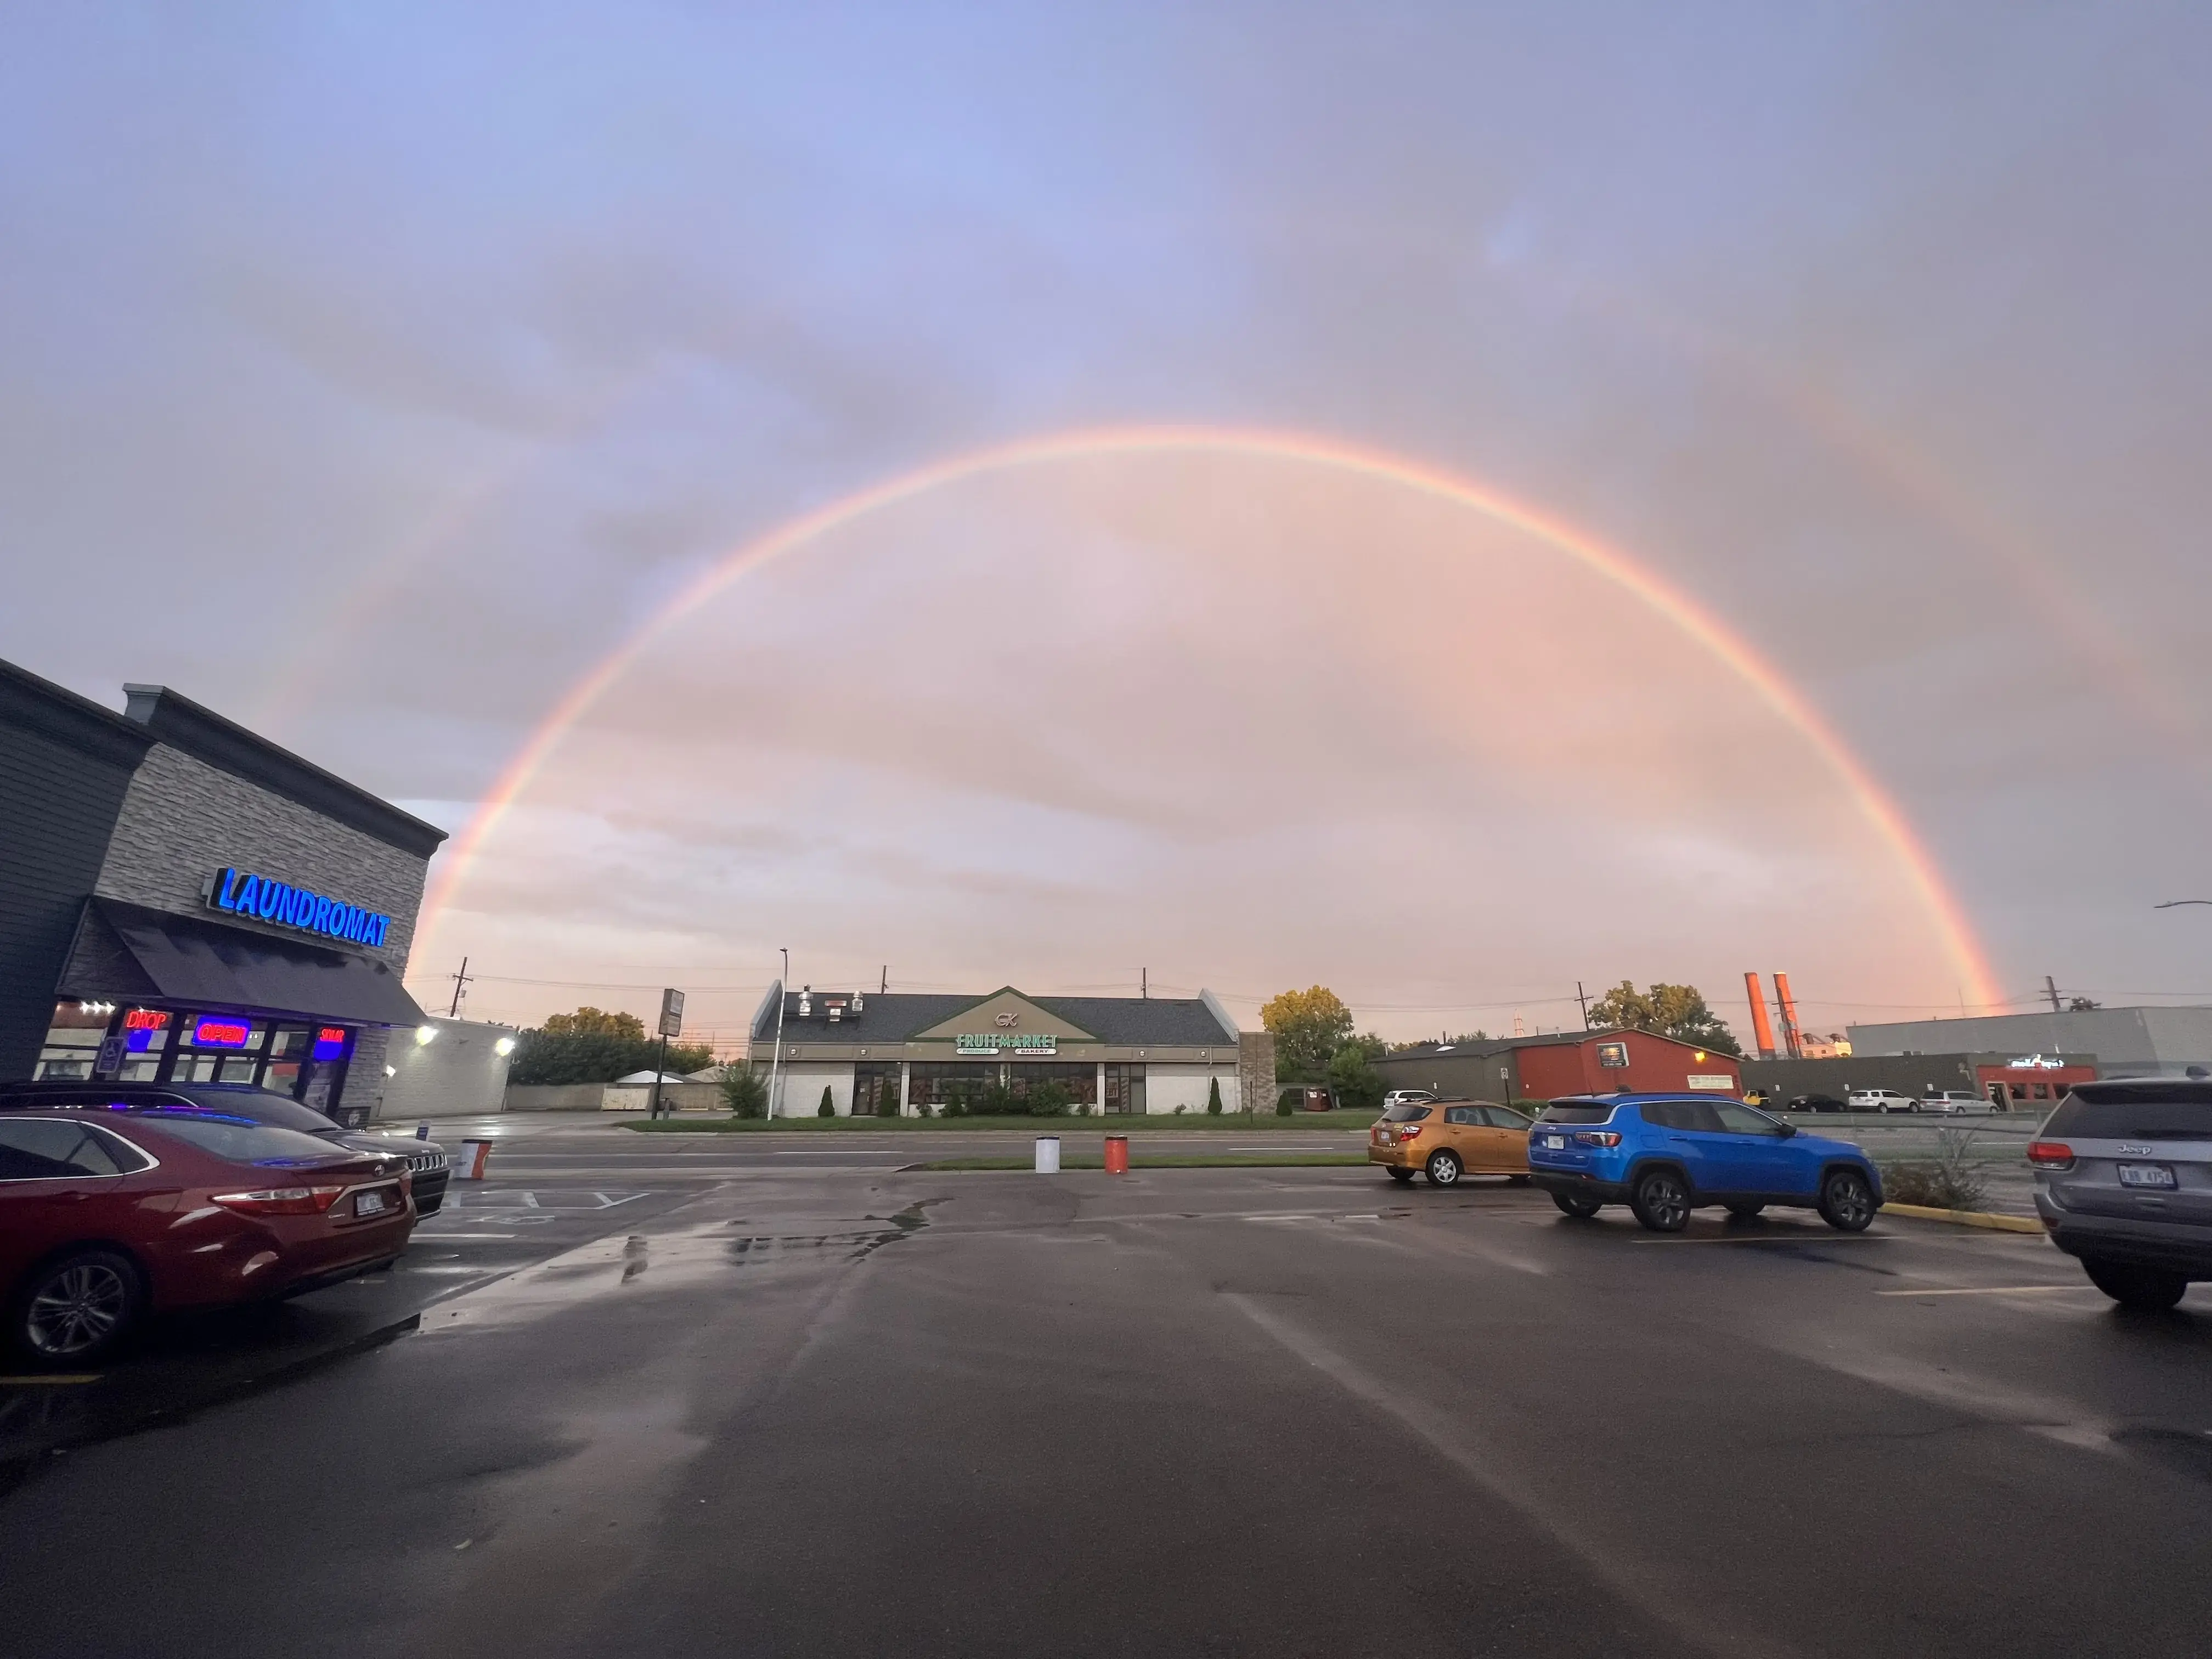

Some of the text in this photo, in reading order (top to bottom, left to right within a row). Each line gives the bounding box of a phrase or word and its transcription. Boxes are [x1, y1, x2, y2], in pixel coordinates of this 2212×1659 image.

[219, 868, 390, 947] LAUNDROMAT
[127, 1011, 167, 1029] DROP
[199, 1024, 246, 1043] OPEN
[2119, 1144, 2151, 1155] Jeep
